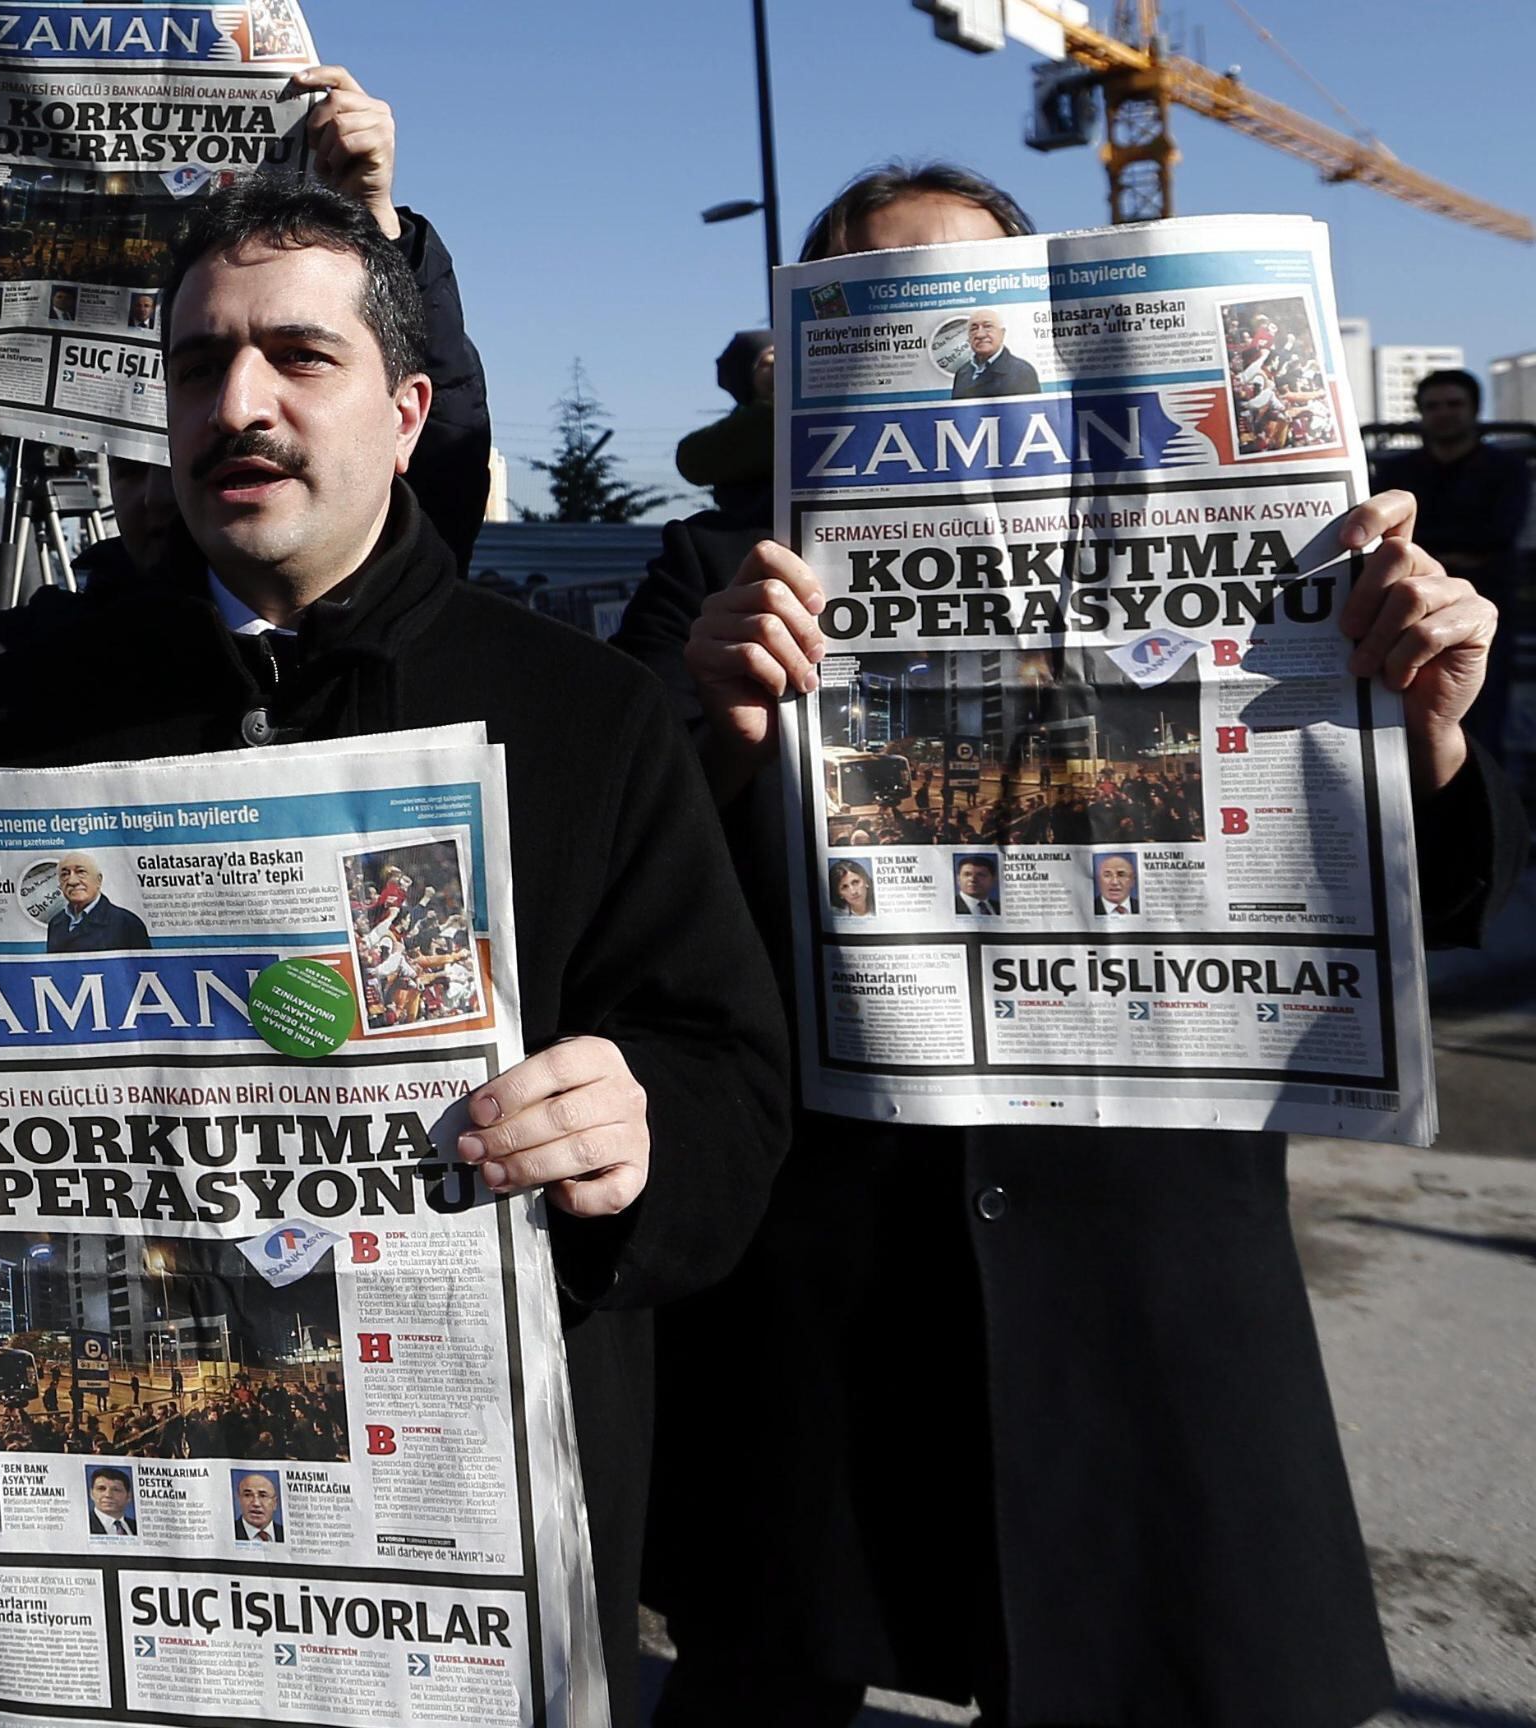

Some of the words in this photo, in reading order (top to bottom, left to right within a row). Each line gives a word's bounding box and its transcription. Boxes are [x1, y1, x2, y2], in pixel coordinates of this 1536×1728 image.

[50, 84, 65, 96] EN
[103, 85, 110, 96] 3
[112, 85, 170, 97] BANKADAN
[173, 84, 195, 98] BİRİ
[197, 87, 225, 99] OLAN
[228, 88, 257, 100] BANK
[8, 98, 277, 133] KORKUTMA
[868, 284, 897, 299] YGS
[901, 279, 961, 297] deneme
[964, 274, 1019, 296] derginiz
[1069, 262, 1147, 285] bayilerde
[1033, 304, 1132, 323] Galatasaray'da
[1135, 300, 1185, 315] Başkan
[807, 324, 871, 341] Türkiye'nin
[873, 322, 913, 339] eriyen
[1150, 315, 1185, 332] tepki
[807, 340, 890, 357] demokrasisini
[893, 337, 927, 354] yazdı
[64, 345, 113, 373] SUÇ
[806, 406, 1144, 478] ZAMAN
[815, 524, 908, 542] SERMAYESİ
[913, 522, 934, 538] EN
[939, 516, 995, 537] GÜÇLÜ
[999, 519, 1007, 535] 3
[1013, 513, 1105, 534] BANKADAN
[1110, 509, 1147, 528] BİRİ
[1151, 508, 1199, 526] OLAN
[1205, 505, 1255, 523] BANK
[1260, 501, 1334, 519] ASYA'YA
[848, 530, 1299, 592] KORKUTMA
[817, 577, 1336, 640] OPERASYONU
[50, 813, 118, 835] derginiz
[122, 811, 174, 832] bugün
[178, 805, 260, 830] bayilerde
[137, 852, 246, 870] Galatasaray'da
[250, 849, 303, 866] Başkan
[137, 871, 214, 888] Yarsuvat'a
[265, 867, 303, 886] tepki
[832, 970, 917, 984] Anahtarlarını
[992, 957, 1076, 997] SUÇ
[1088, 951, 1362, 999] İŞLİYORLAR
[832, 983, 894, 996] masamda
[897, 984, 957, 998] istiyorum
[282, 1002, 316, 1023] ALMAYI
[19, 1089, 43, 1107] EN
[47, 1084, 108, 1109] GÜÇLÜ
[113, 1087, 123, 1105] 3
[127, 1086, 231, 1106] BANKADAN
[236, 1082, 273, 1104] BİRİ
[279, 1085, 331, 1105] OLAN
[336, 1083, 390, 1104] BANK
[395, 1079, 471, 1101] ASYA'YA
[265, 1250, 303, 1277] BANK
[302, 1230, 329, 1252] ASYA
[349, 1231, 381, 1264] B
[357, 1333, 394, 1363] H
[397, 1334, 444, 1343] UKUKSUZ
[365, 1424, 397, 1456] B
[24, 1464, 49, 1474] BANK
[137, 1464, 209, 1478] İMKANLARIMLA
[3, 1487, 29, 1497] DEME
[30, 1487, 65, 1497] ZAMANI
[138, 1478, 173, 1489] DESTEK
[139, 1488, 187, 1500] OLACAĞIM
[287, 1482, 351, 1495] YATIRACAĞIM
[377, 1546, 396, 1557] Mali
[398, 1547, 433, 1561] darbeye
[435, 1550, 446, 1560] de
[26, 1610, 92, 1628] istiyorum
[130, 1585, 220, 1635] SUÇ
[229, 1581, 512, 1649] İŞLİYORLAR
[434, 1655, 505, 1667] ULUSLARARASI
